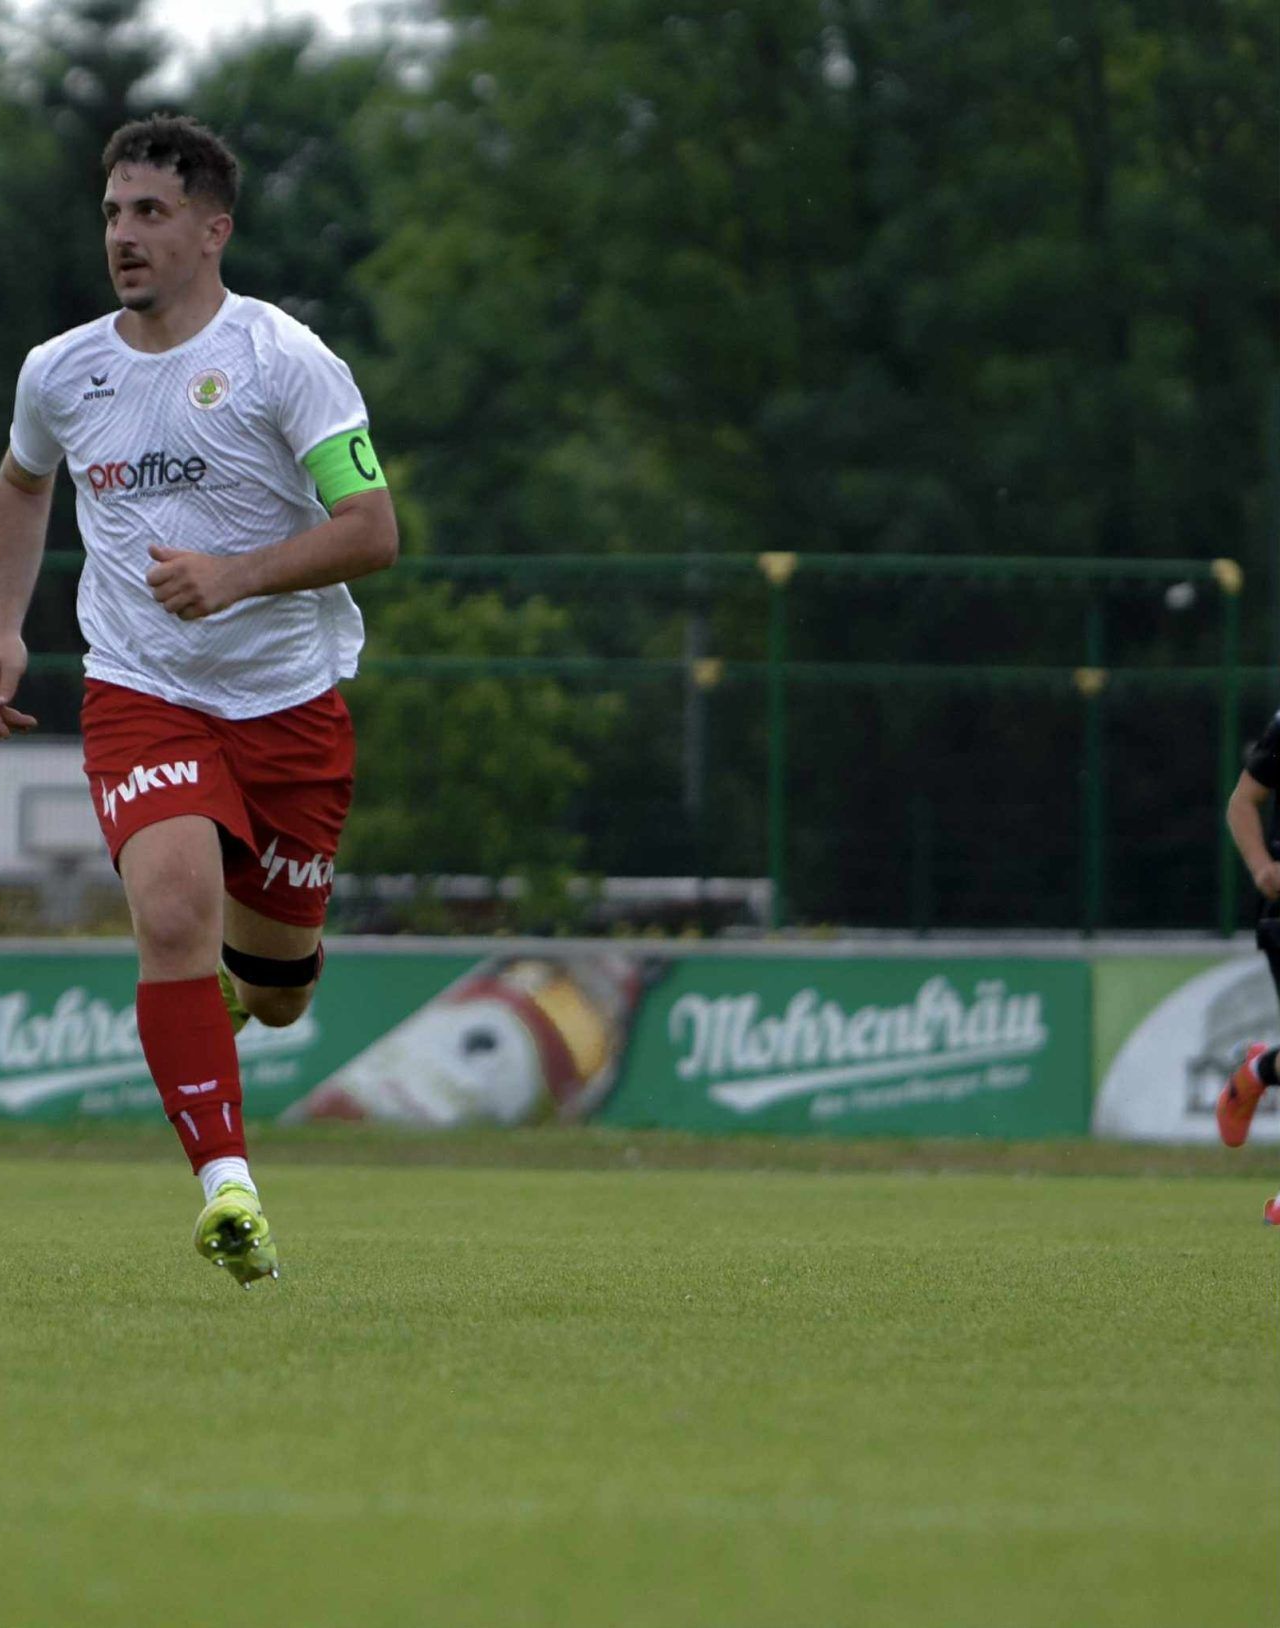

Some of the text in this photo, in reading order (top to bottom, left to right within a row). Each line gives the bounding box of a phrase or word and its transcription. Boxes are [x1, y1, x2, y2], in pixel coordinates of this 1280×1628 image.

[83, 388, 115, 400] erima
[87, 451, 207, 500] proffice
[349, 435, 377, 481] C
[117, 760, 198, 803] vkw
[668, 974, 1048, 1080] Mohrenbräu
